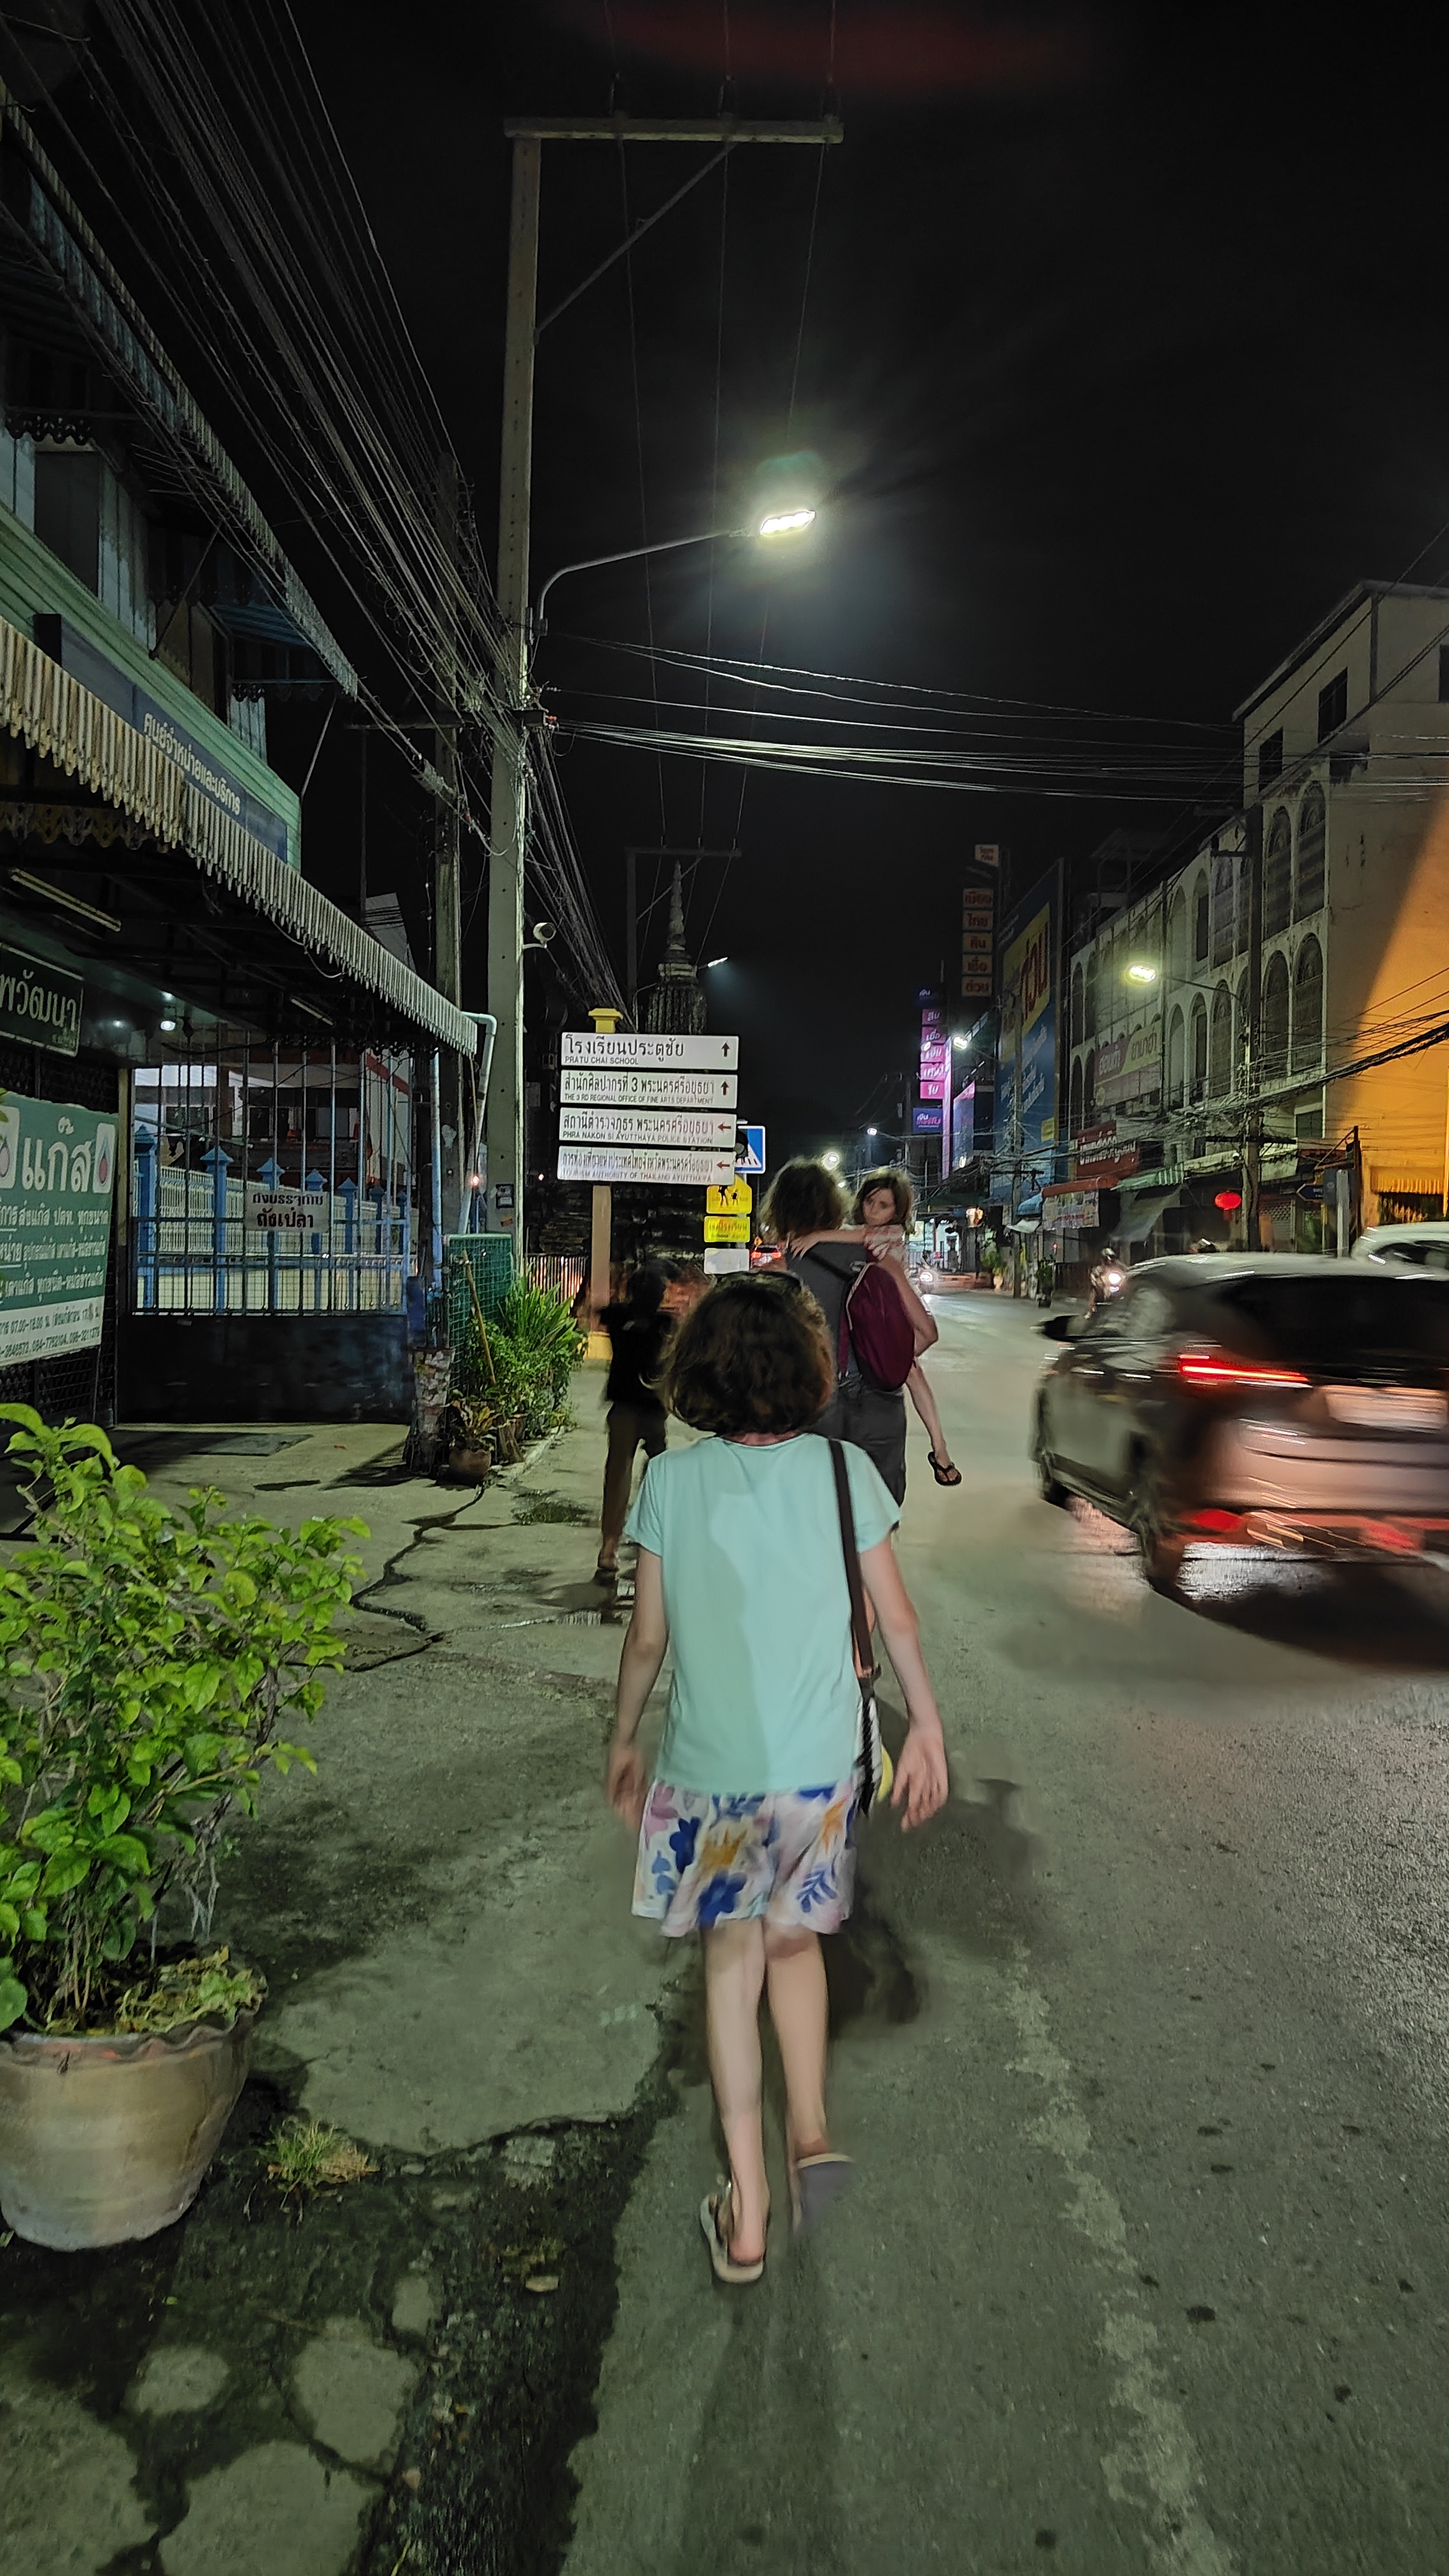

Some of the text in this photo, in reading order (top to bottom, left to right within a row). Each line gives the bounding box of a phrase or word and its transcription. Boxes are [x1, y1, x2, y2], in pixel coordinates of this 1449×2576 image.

[143, 713, 241, 815] ศนย์จำหน่ายและบริการ
[565, 1034, 684, 1062] โรงเรียนประตูชัย
[565, 1071, 714, 1097] สำนักศิลปากรที่ 3 พระนครศรีอยุธยา
[616, 1133, 655, 1142] AYUTTHAYA
[657, 1135, 680, 1143] POLICE
[636, 1114, 714, 1136] พระนครศรีอยุธยา
